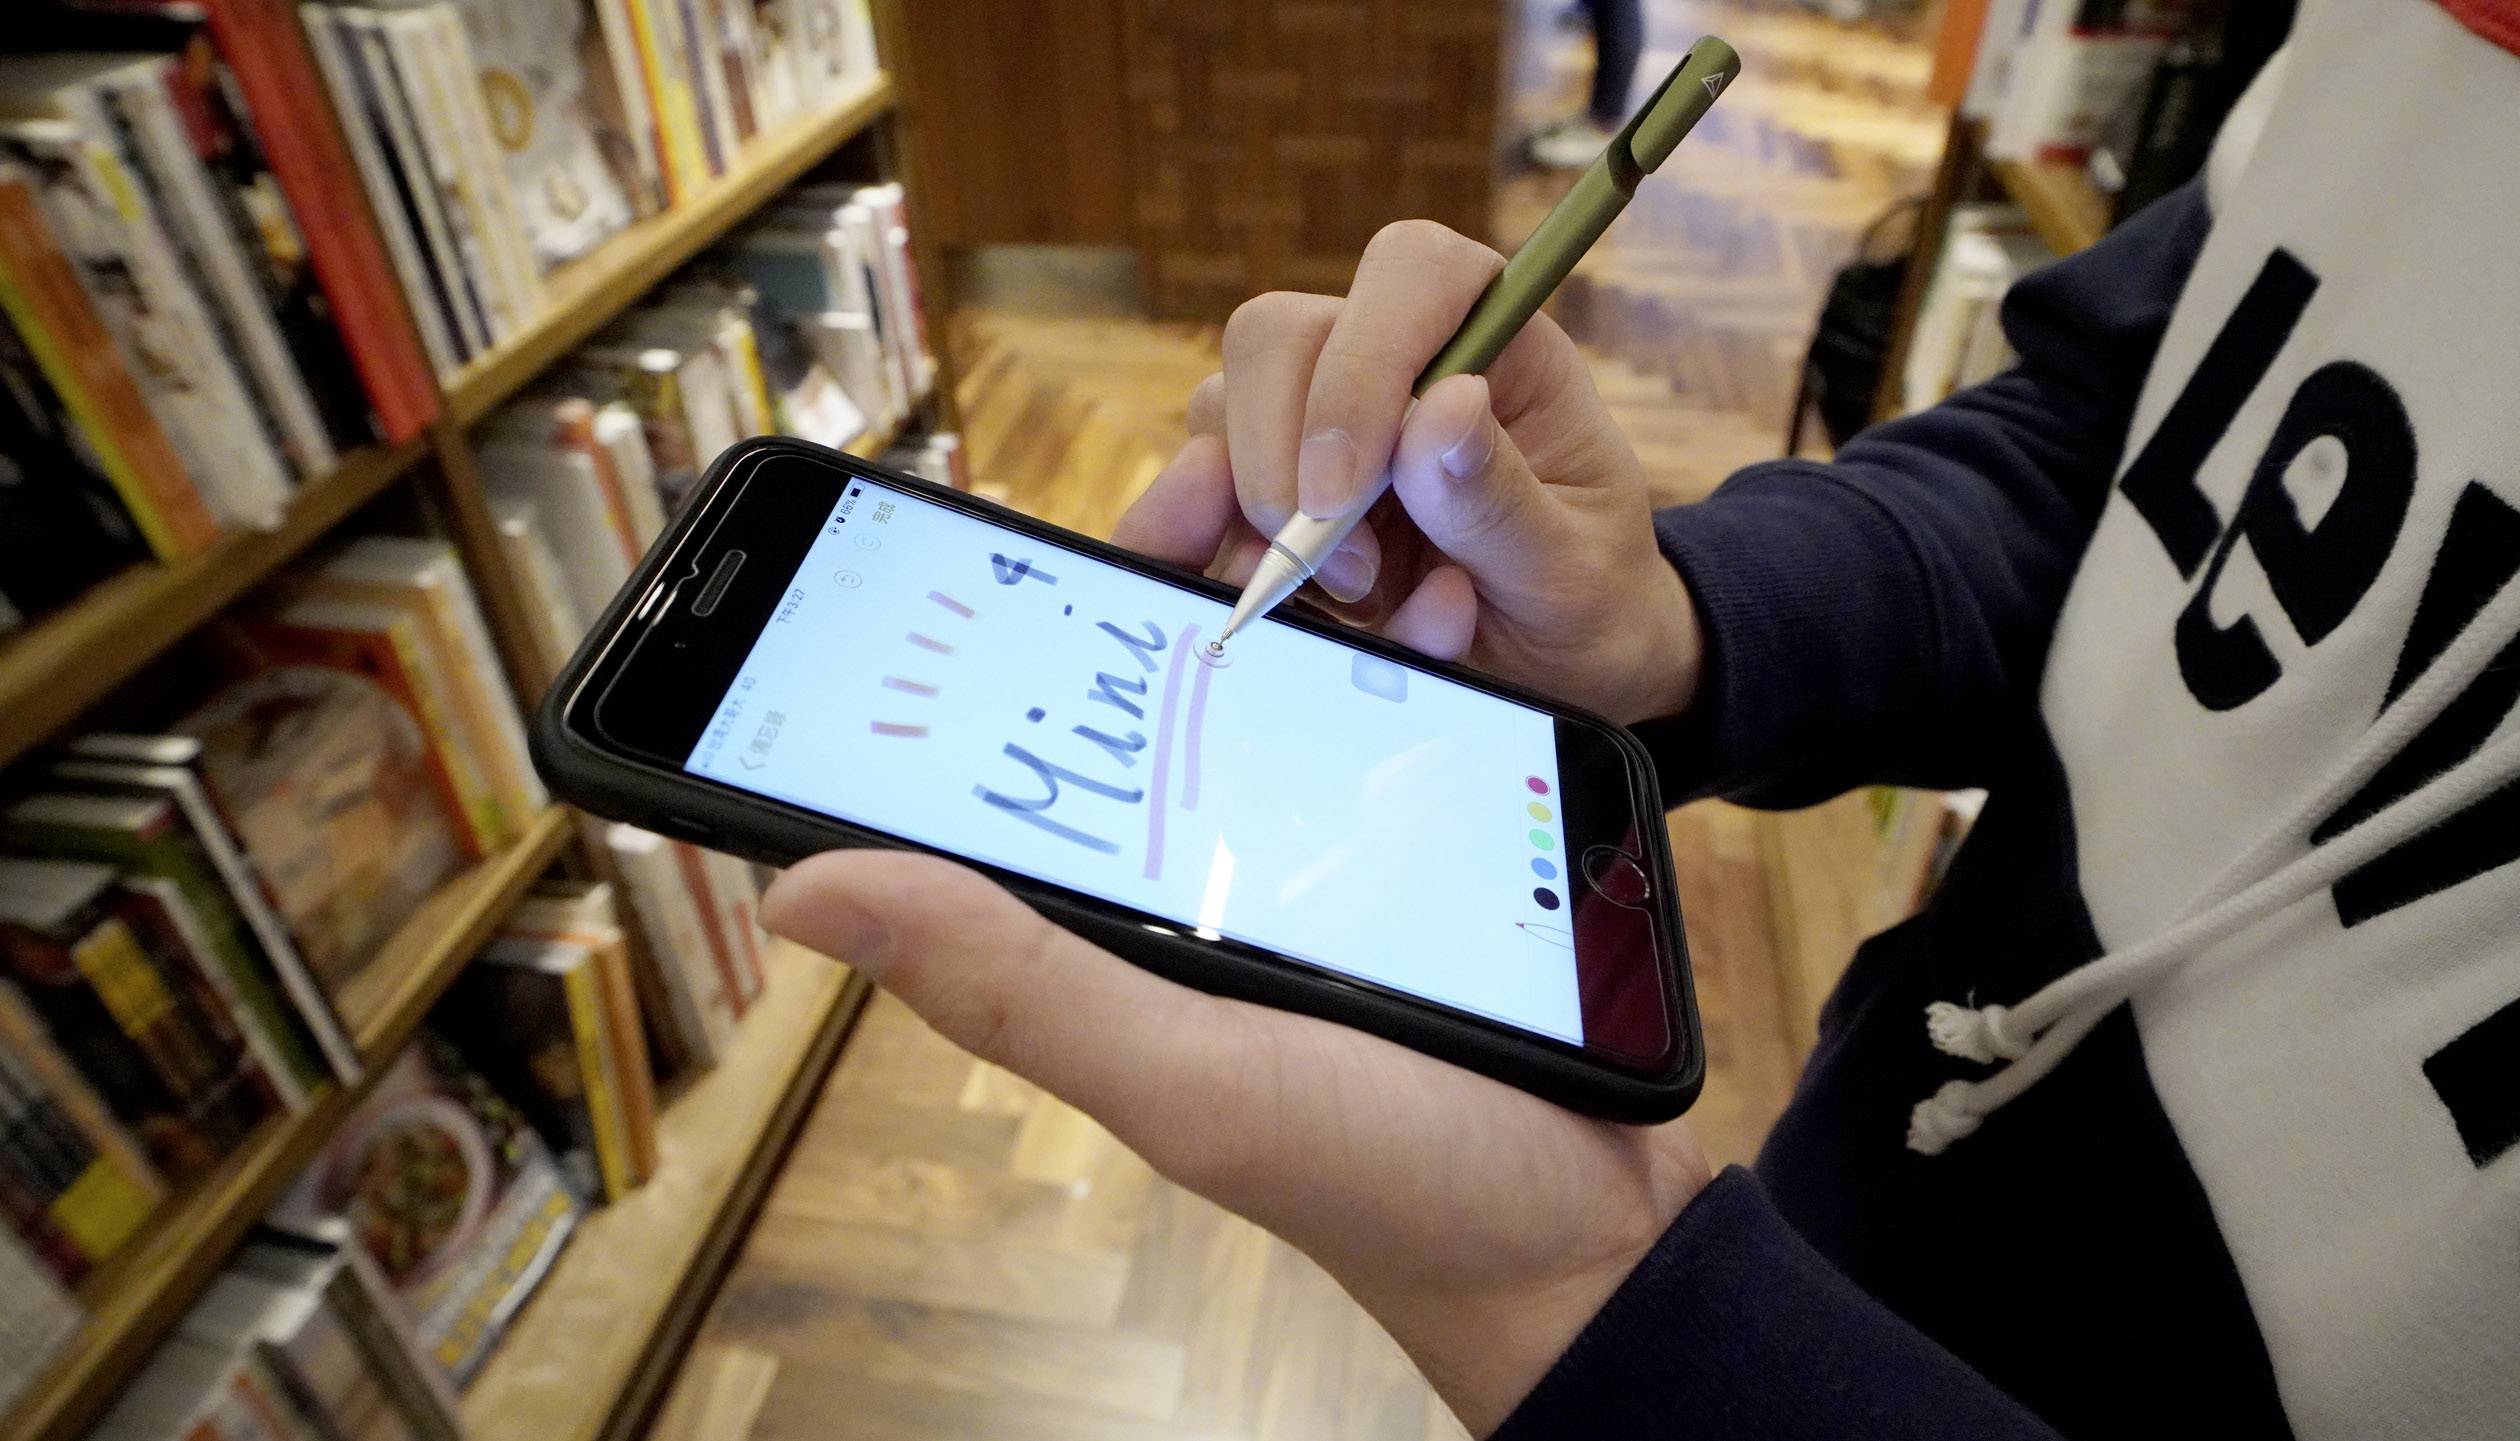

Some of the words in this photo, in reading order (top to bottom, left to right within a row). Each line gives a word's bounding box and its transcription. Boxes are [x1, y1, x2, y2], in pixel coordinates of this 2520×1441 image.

[840, 499, 857, 516] 66%
[872, 501, 896, 525] 完成
[989, 552, 1059, 586] 4
[972, 604, 1167, 857] Mini
